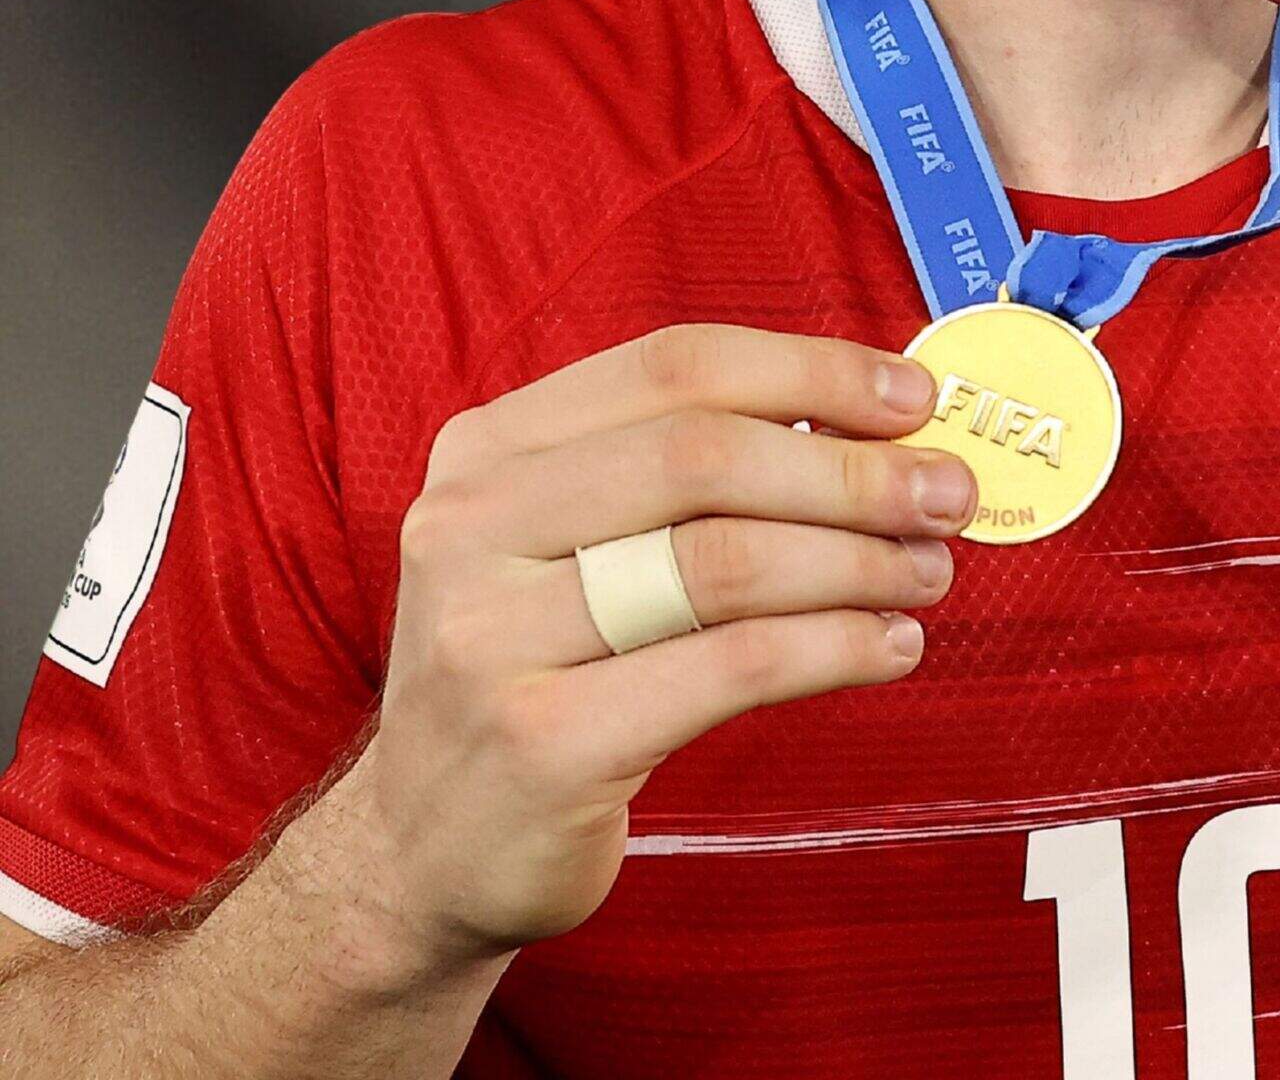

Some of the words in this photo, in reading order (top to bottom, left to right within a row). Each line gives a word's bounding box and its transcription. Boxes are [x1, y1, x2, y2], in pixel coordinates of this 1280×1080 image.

[932, 371, 1064, 470] FIFA
[976, 506, 1036, 528] PION
[74, 573, 102, 601] CUP
